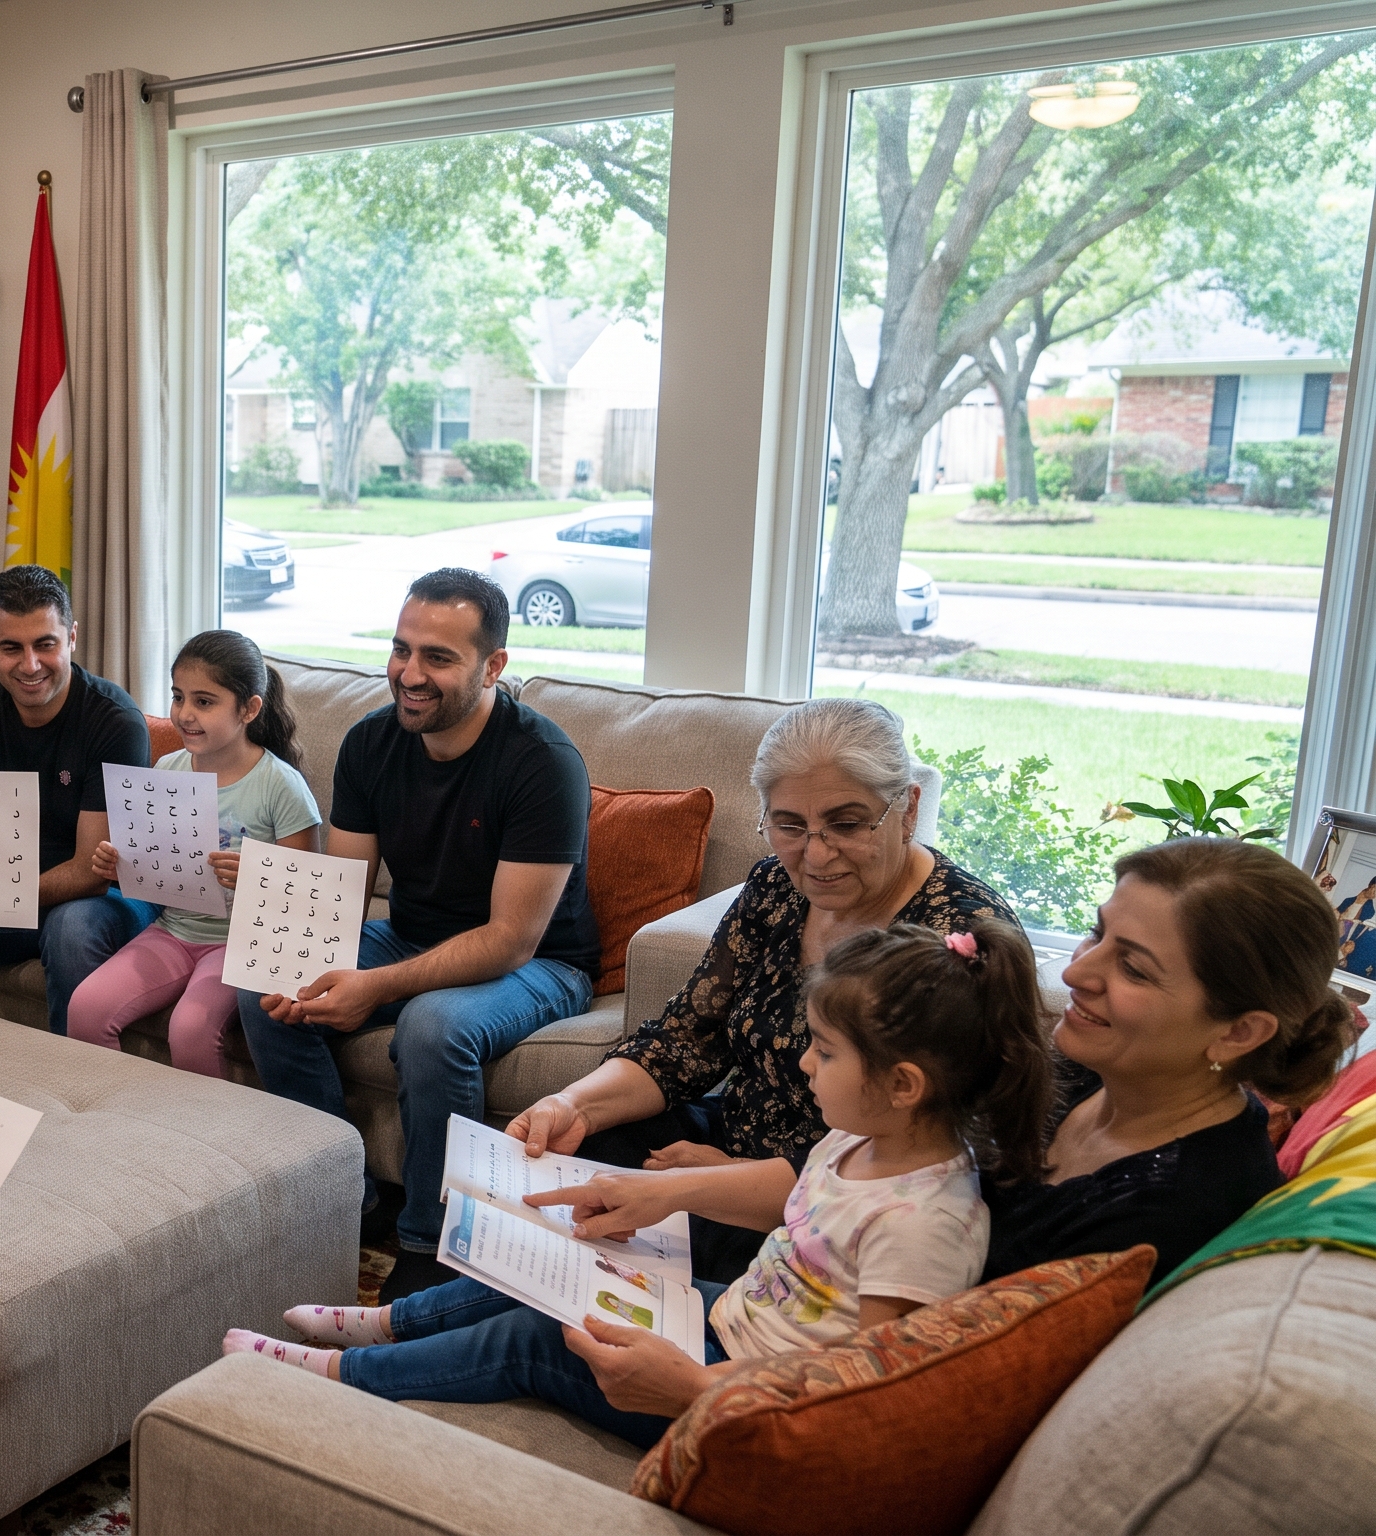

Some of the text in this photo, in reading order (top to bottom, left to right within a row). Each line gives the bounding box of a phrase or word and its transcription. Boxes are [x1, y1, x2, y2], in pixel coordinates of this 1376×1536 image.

[166, 787, 178, 798] ب
[146, 800, 155, 816] خ
[7, 854, 23, 865] ص
[151, 859, 160, 871] ل
[194, 864, 204, 876] ل
[310, 870, 323, 881] ب
[11, 871, 21, 884] ل
[284, 881, 295, 896] خ
[272, 925, 290, 934] ص
[323, 935, 341, 945] ص
[272, 941, 283, 954] ل
[323, 952, 335, 964] ل
[294, 970, 303, 980] و
